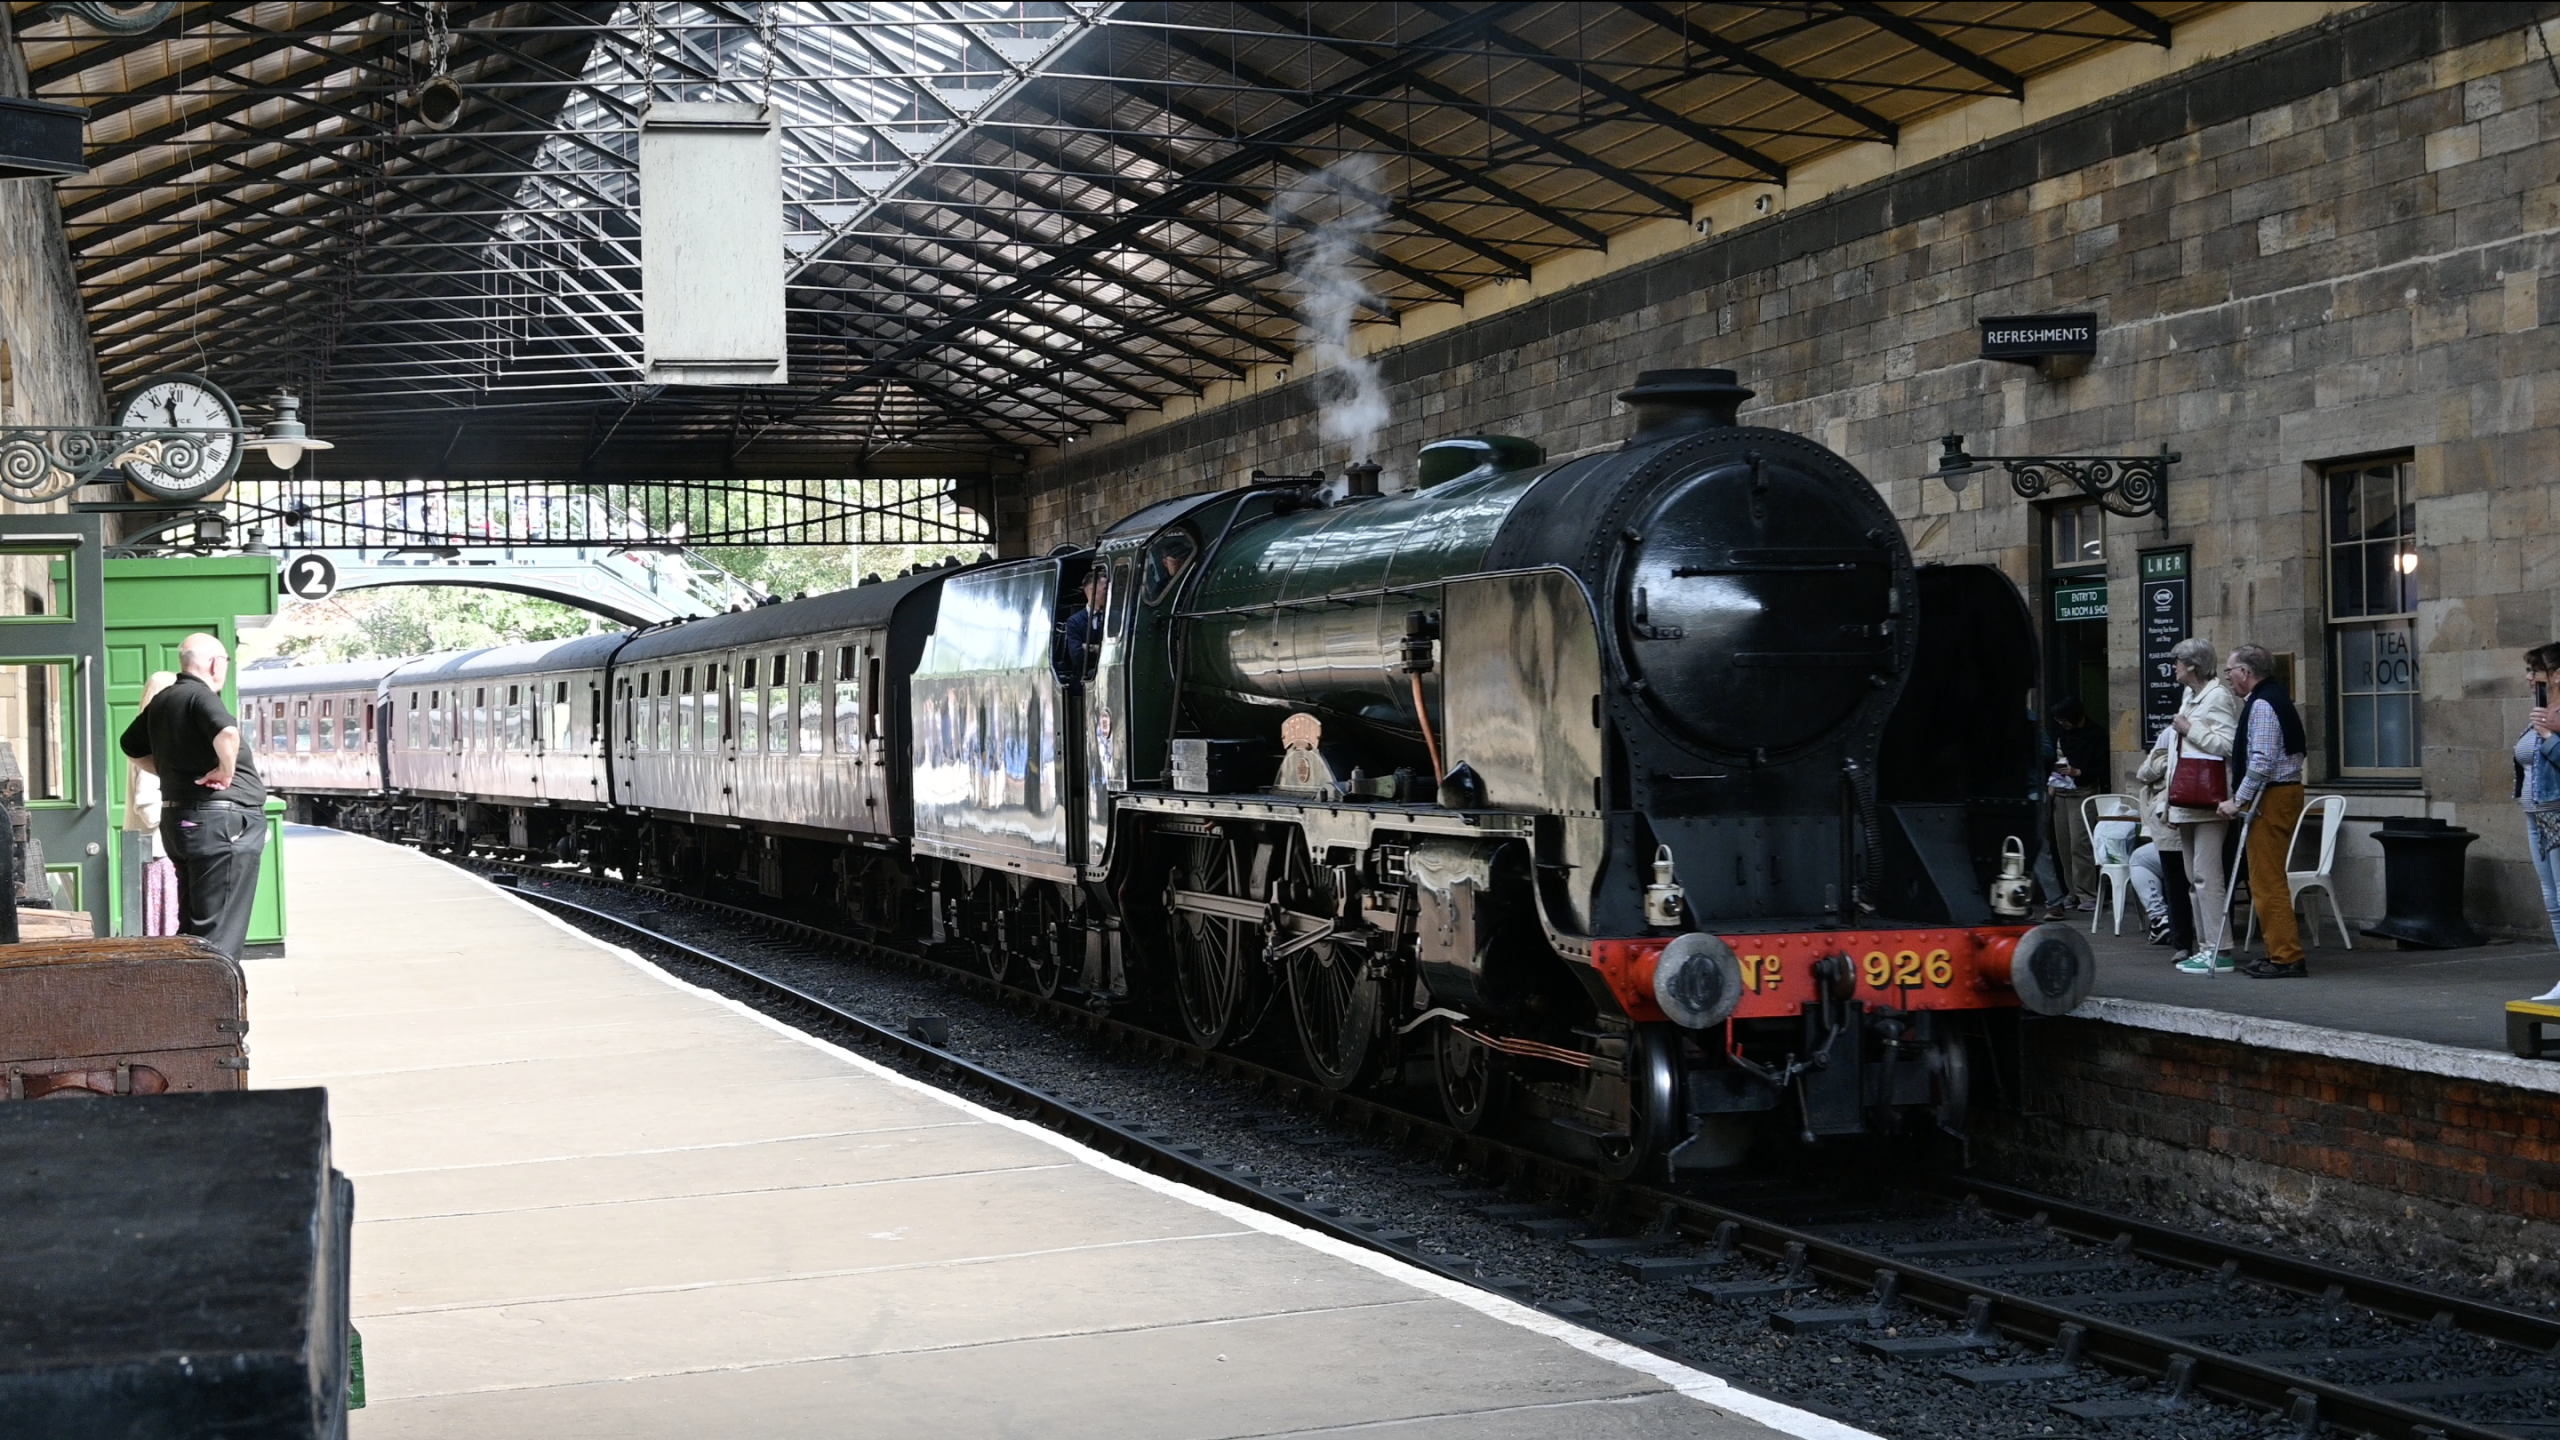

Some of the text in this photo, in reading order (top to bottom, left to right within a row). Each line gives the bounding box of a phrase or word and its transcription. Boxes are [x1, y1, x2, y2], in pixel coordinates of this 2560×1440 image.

[1988, 327, 2089, 344] REFRESHMENTS
[2148, 556, 2181, 573] LNER
[300, 560, 328, 594] 2
[2072, 592, 2097, 602] ENTRY TO
[2061, 608, 2071, 617] TEA
[2072, 606, 2088, 616] ROOM
[2094, 604, 2108, 615] SHO
[2376, 632, 2408, 654] TEA
[1863, 949, 1953, 987] 926
